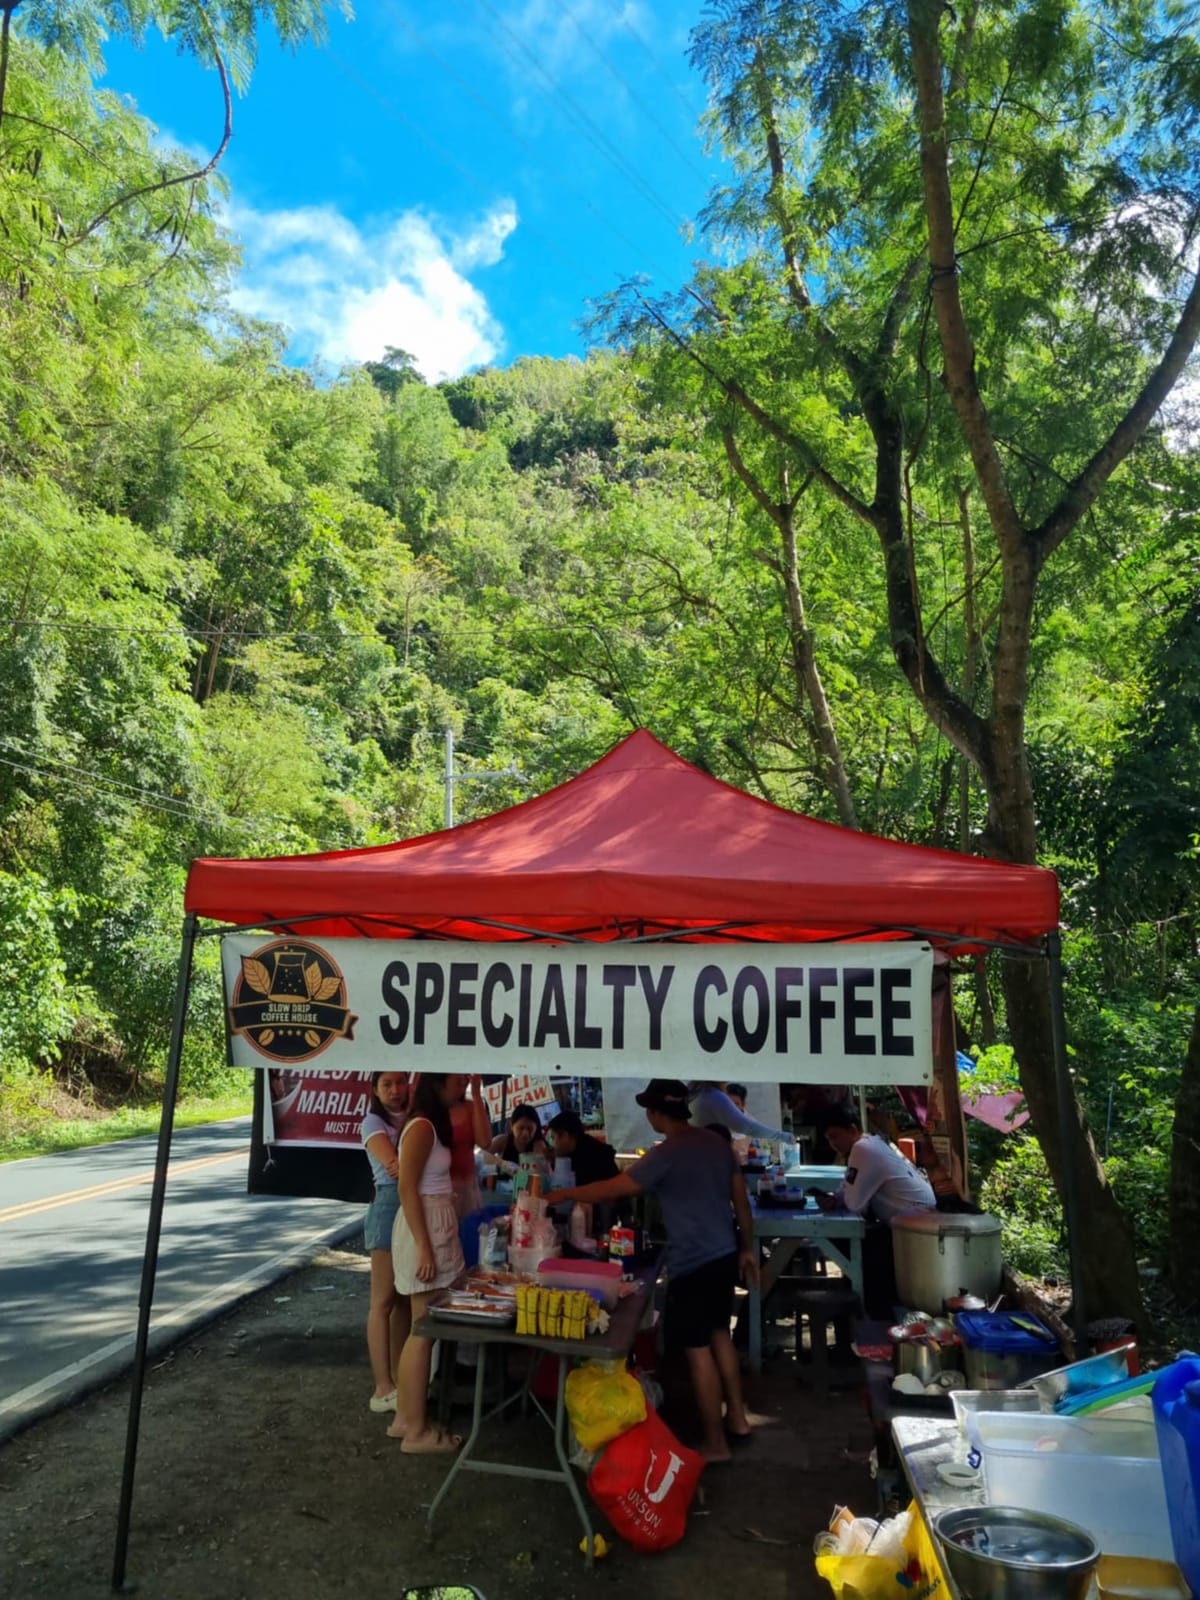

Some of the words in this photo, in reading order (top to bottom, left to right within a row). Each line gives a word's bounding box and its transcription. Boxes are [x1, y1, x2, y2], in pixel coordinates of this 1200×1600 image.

[268, 1003, 290, 1013] SLOW
[292, 1004, 311, 1013] DRIP
[379, 960, 675, 1051] SPECIALTY
[693, 964, 915, 1057] COFFEE
[261, 1012, 289, 1022] COFFEE
[291, 1013, 318, 1023] HOUSE
[296, 1090, 371, 1117] MARILA
[324, 1121, 352, 1135] MUST
